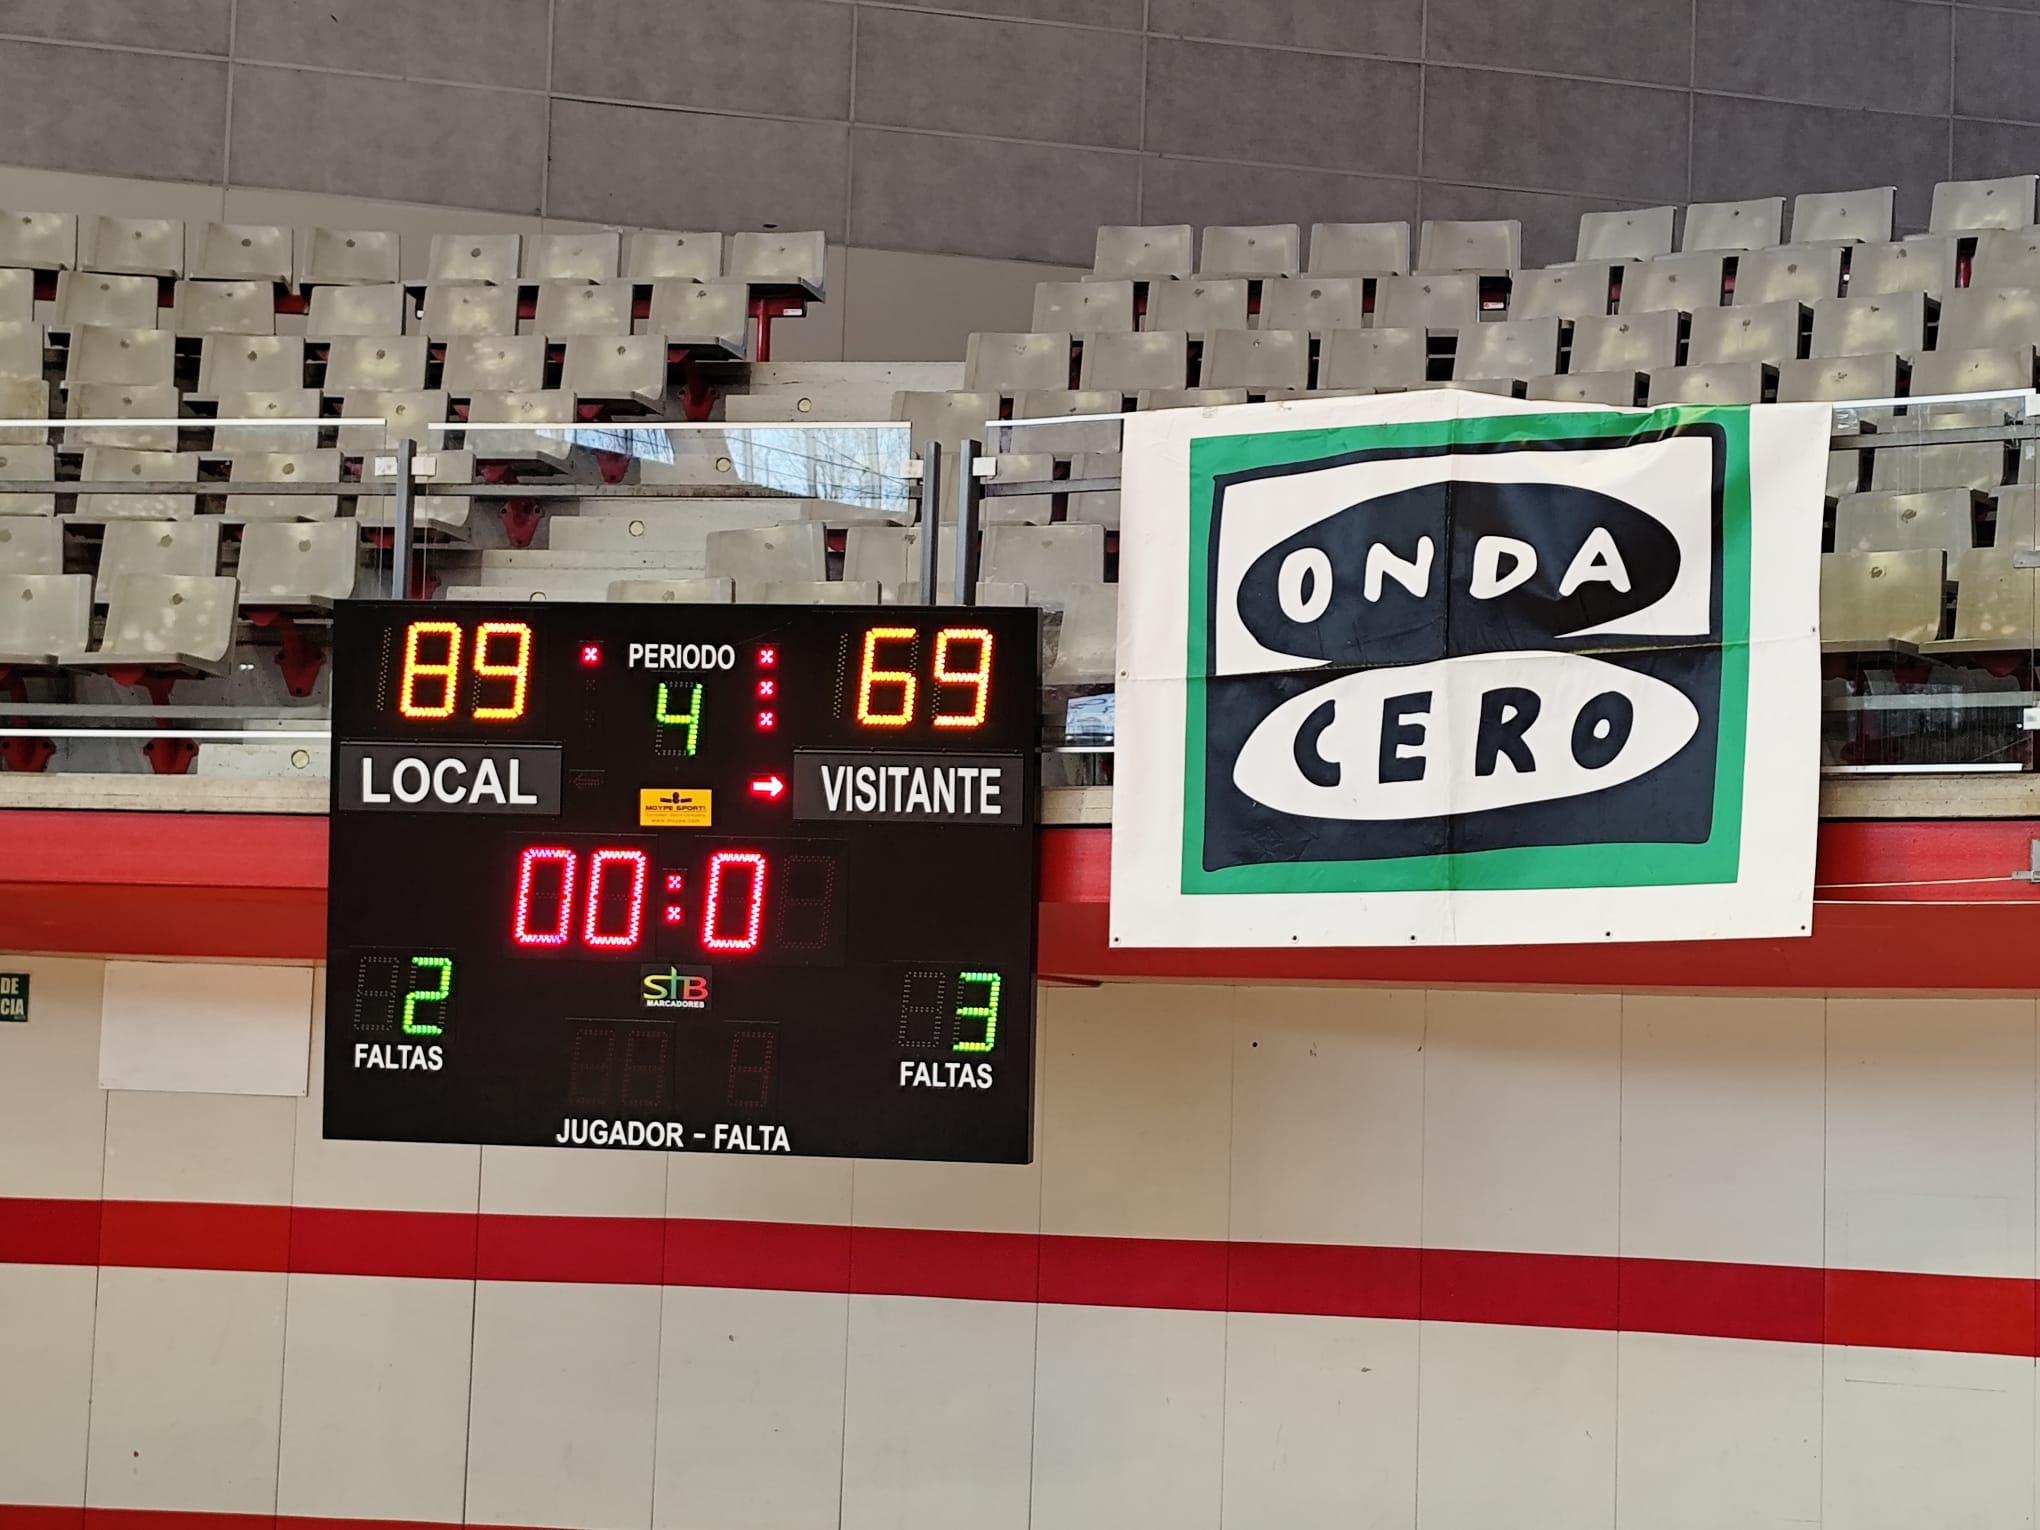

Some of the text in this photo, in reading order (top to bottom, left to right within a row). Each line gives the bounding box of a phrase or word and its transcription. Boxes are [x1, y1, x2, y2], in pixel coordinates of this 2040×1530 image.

[1278, 526, 1631, 623] ONDA
[401, 622, 531, 719] 89
[628, 643, 736, 670] PERIODO
[857, 628, 993, 726] 69
[656, 682, 703, 756] 4
[1293, 687, 1634, 787] CERO
[362, 757, 538, 805] LOCAL
[821, 765, 1002, 815] VISITANTE
[0, 977, 19, 994] DE
[402, 957, 453, 1034] 2
[646, 1000, 705, 1008] MARCADORES
[952, 971, 1001, 1052] 3
[353, 1043, 444, 1071] FALTAS
[899, 1061, 993, 1089] FALTAS
[555, 1118, 684, 1148] JUGADOR
[713, 1124, 791, 1152] FALTA
